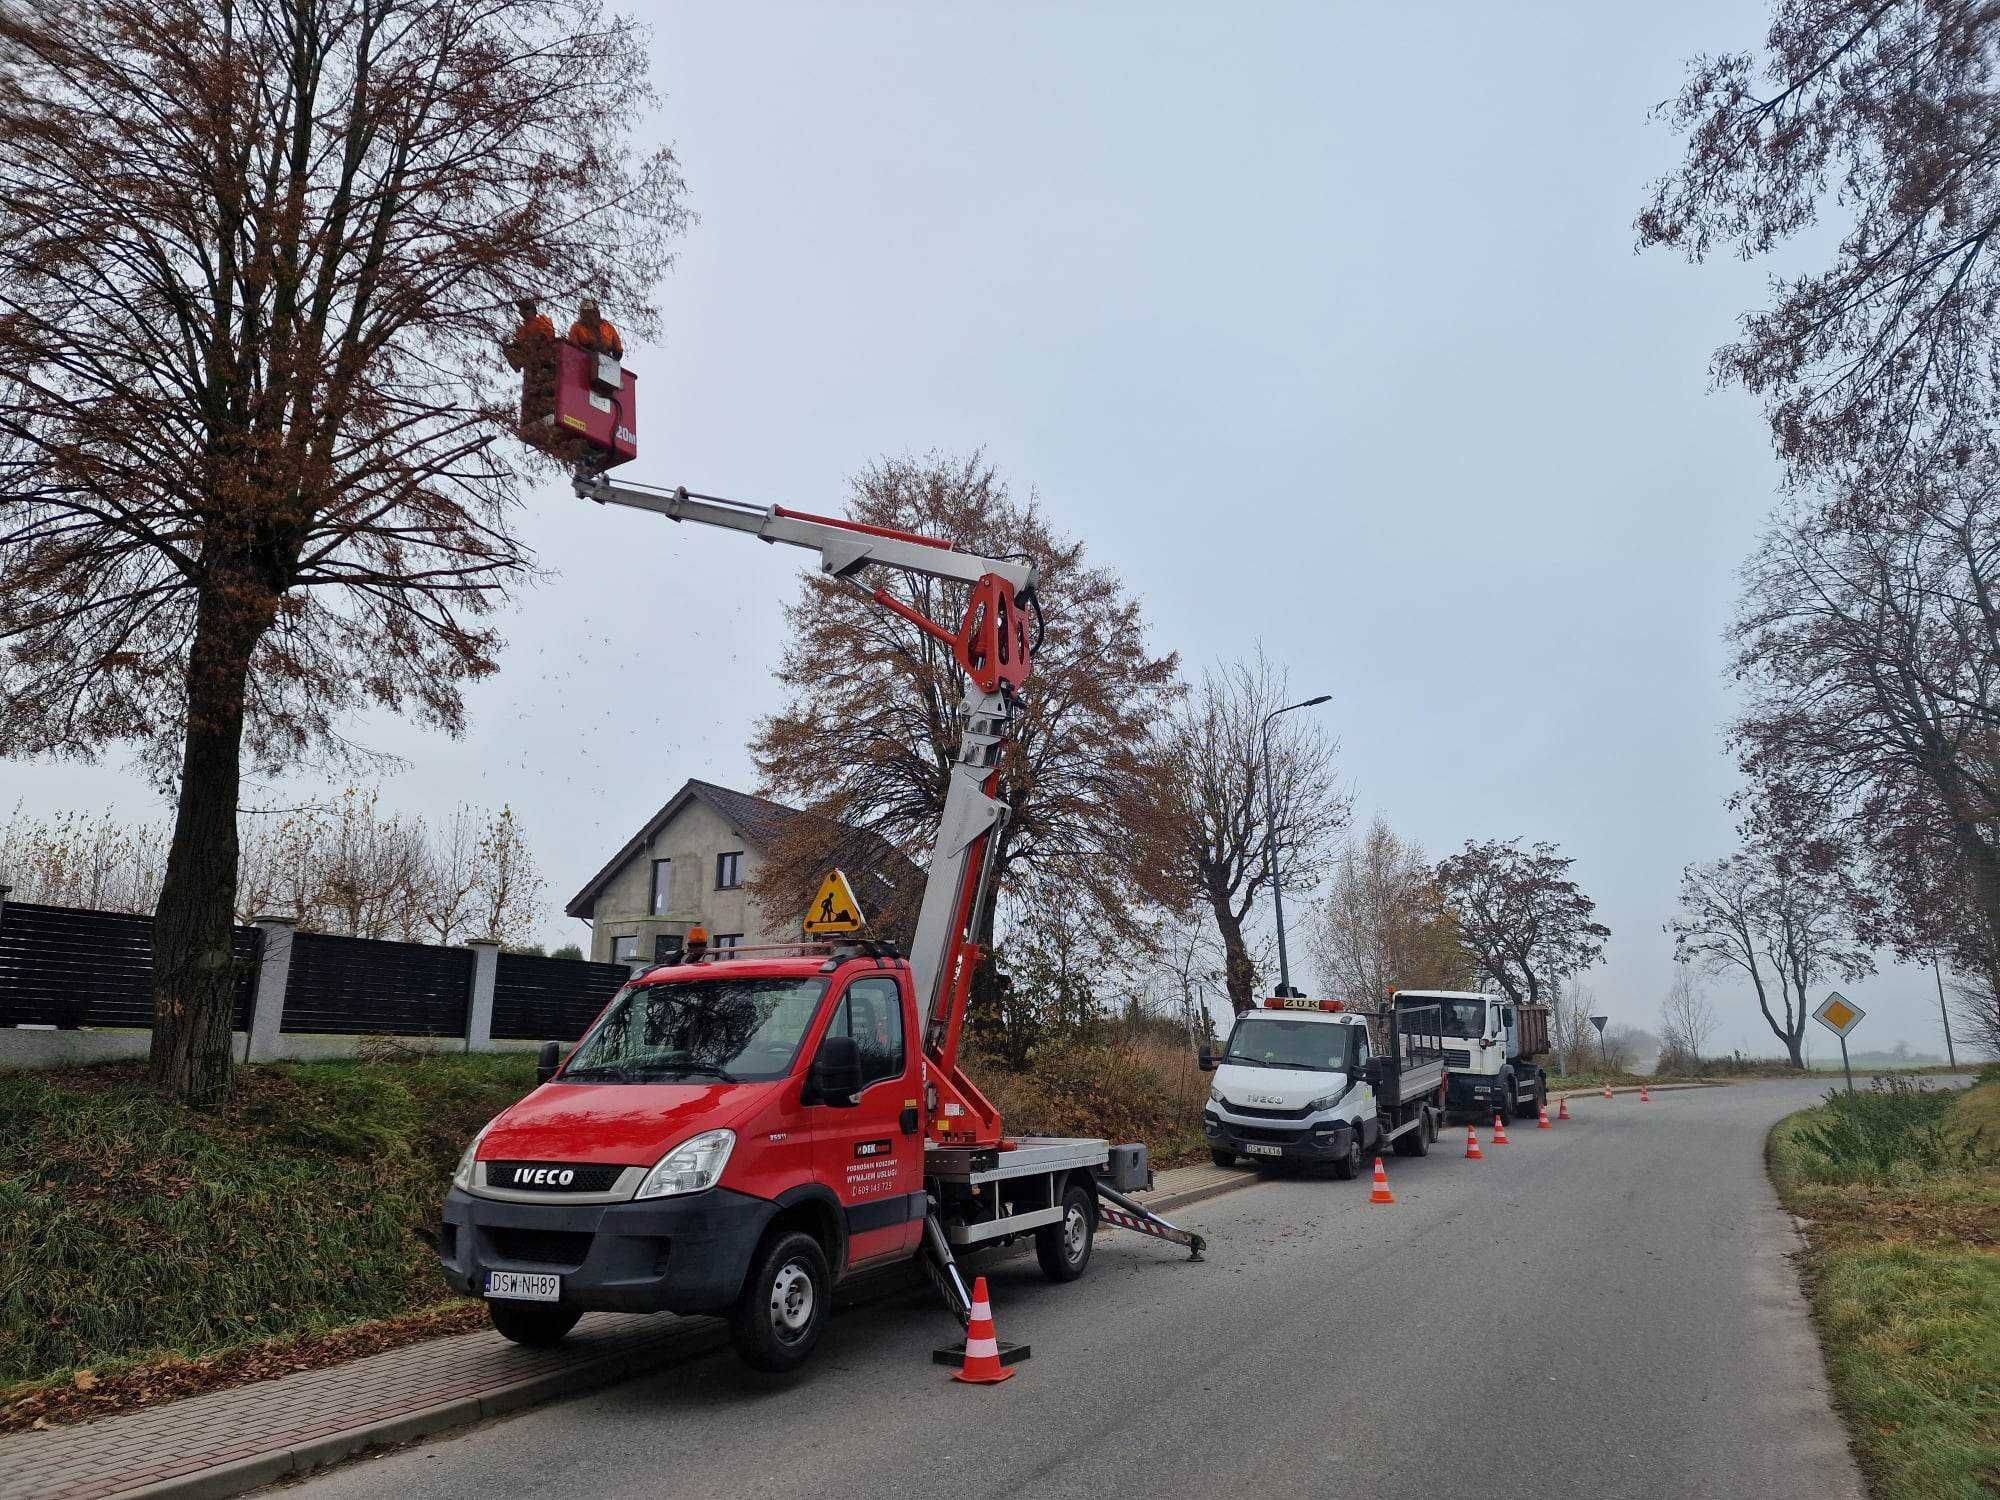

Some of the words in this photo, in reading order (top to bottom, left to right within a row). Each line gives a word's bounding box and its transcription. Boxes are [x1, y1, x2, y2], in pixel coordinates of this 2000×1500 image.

[616, 426, 637, 445] 20m
[1285, 999, 1318, 1008] ZUK
[513, 1168, 574, 1186] IVECO
[493, 1273, 518, 1293] DSW
[522, 1276, 556, 1296] NH89
